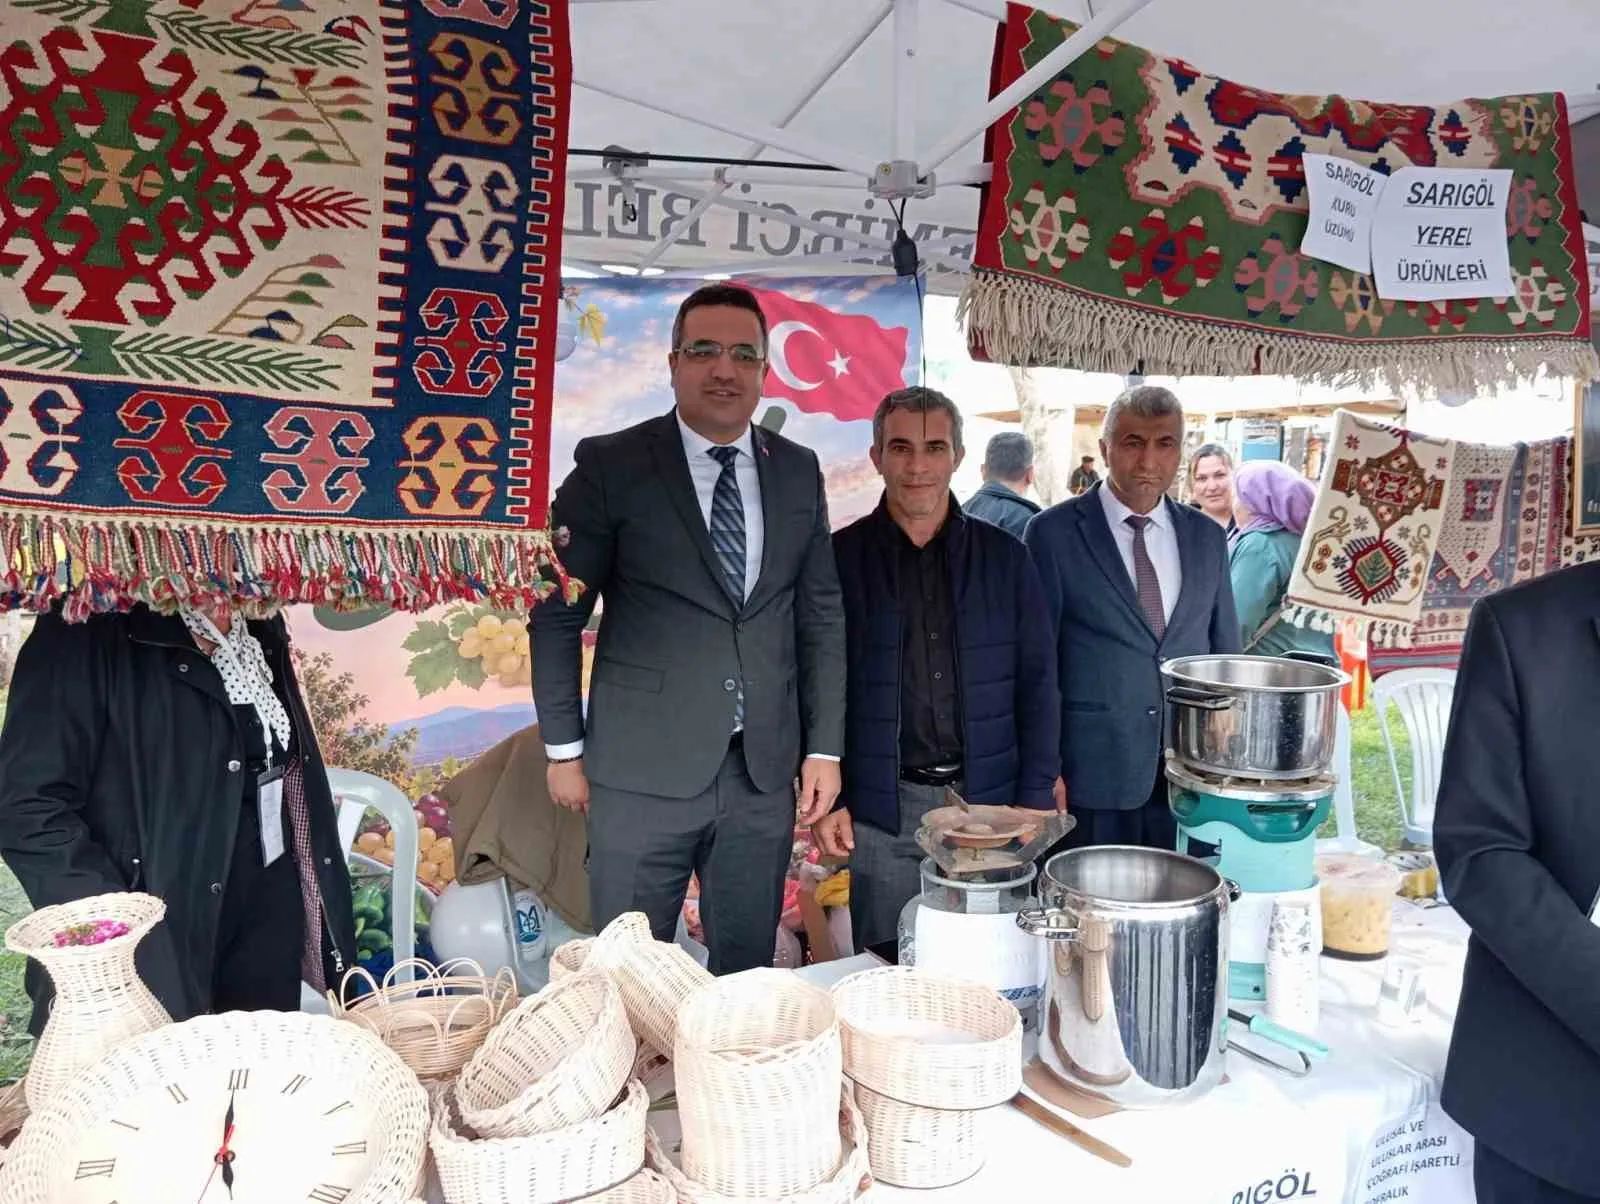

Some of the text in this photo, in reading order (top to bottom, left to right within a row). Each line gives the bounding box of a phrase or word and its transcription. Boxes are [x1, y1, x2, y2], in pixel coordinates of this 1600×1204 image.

[1326, 162, 1376, 196] SARIGÖL
[1406, 178, 1496, 207] SARIGÖL
[1331, 197, 1356, 217] KURU
[1416, 225, 1473, 246] YEREL
[1397, 258, 1488, 282] ÜRÜNLERİ
[1409, 1120, 1425, 1132] VE
[1414, 1135, 1447, 1151] ARASI
